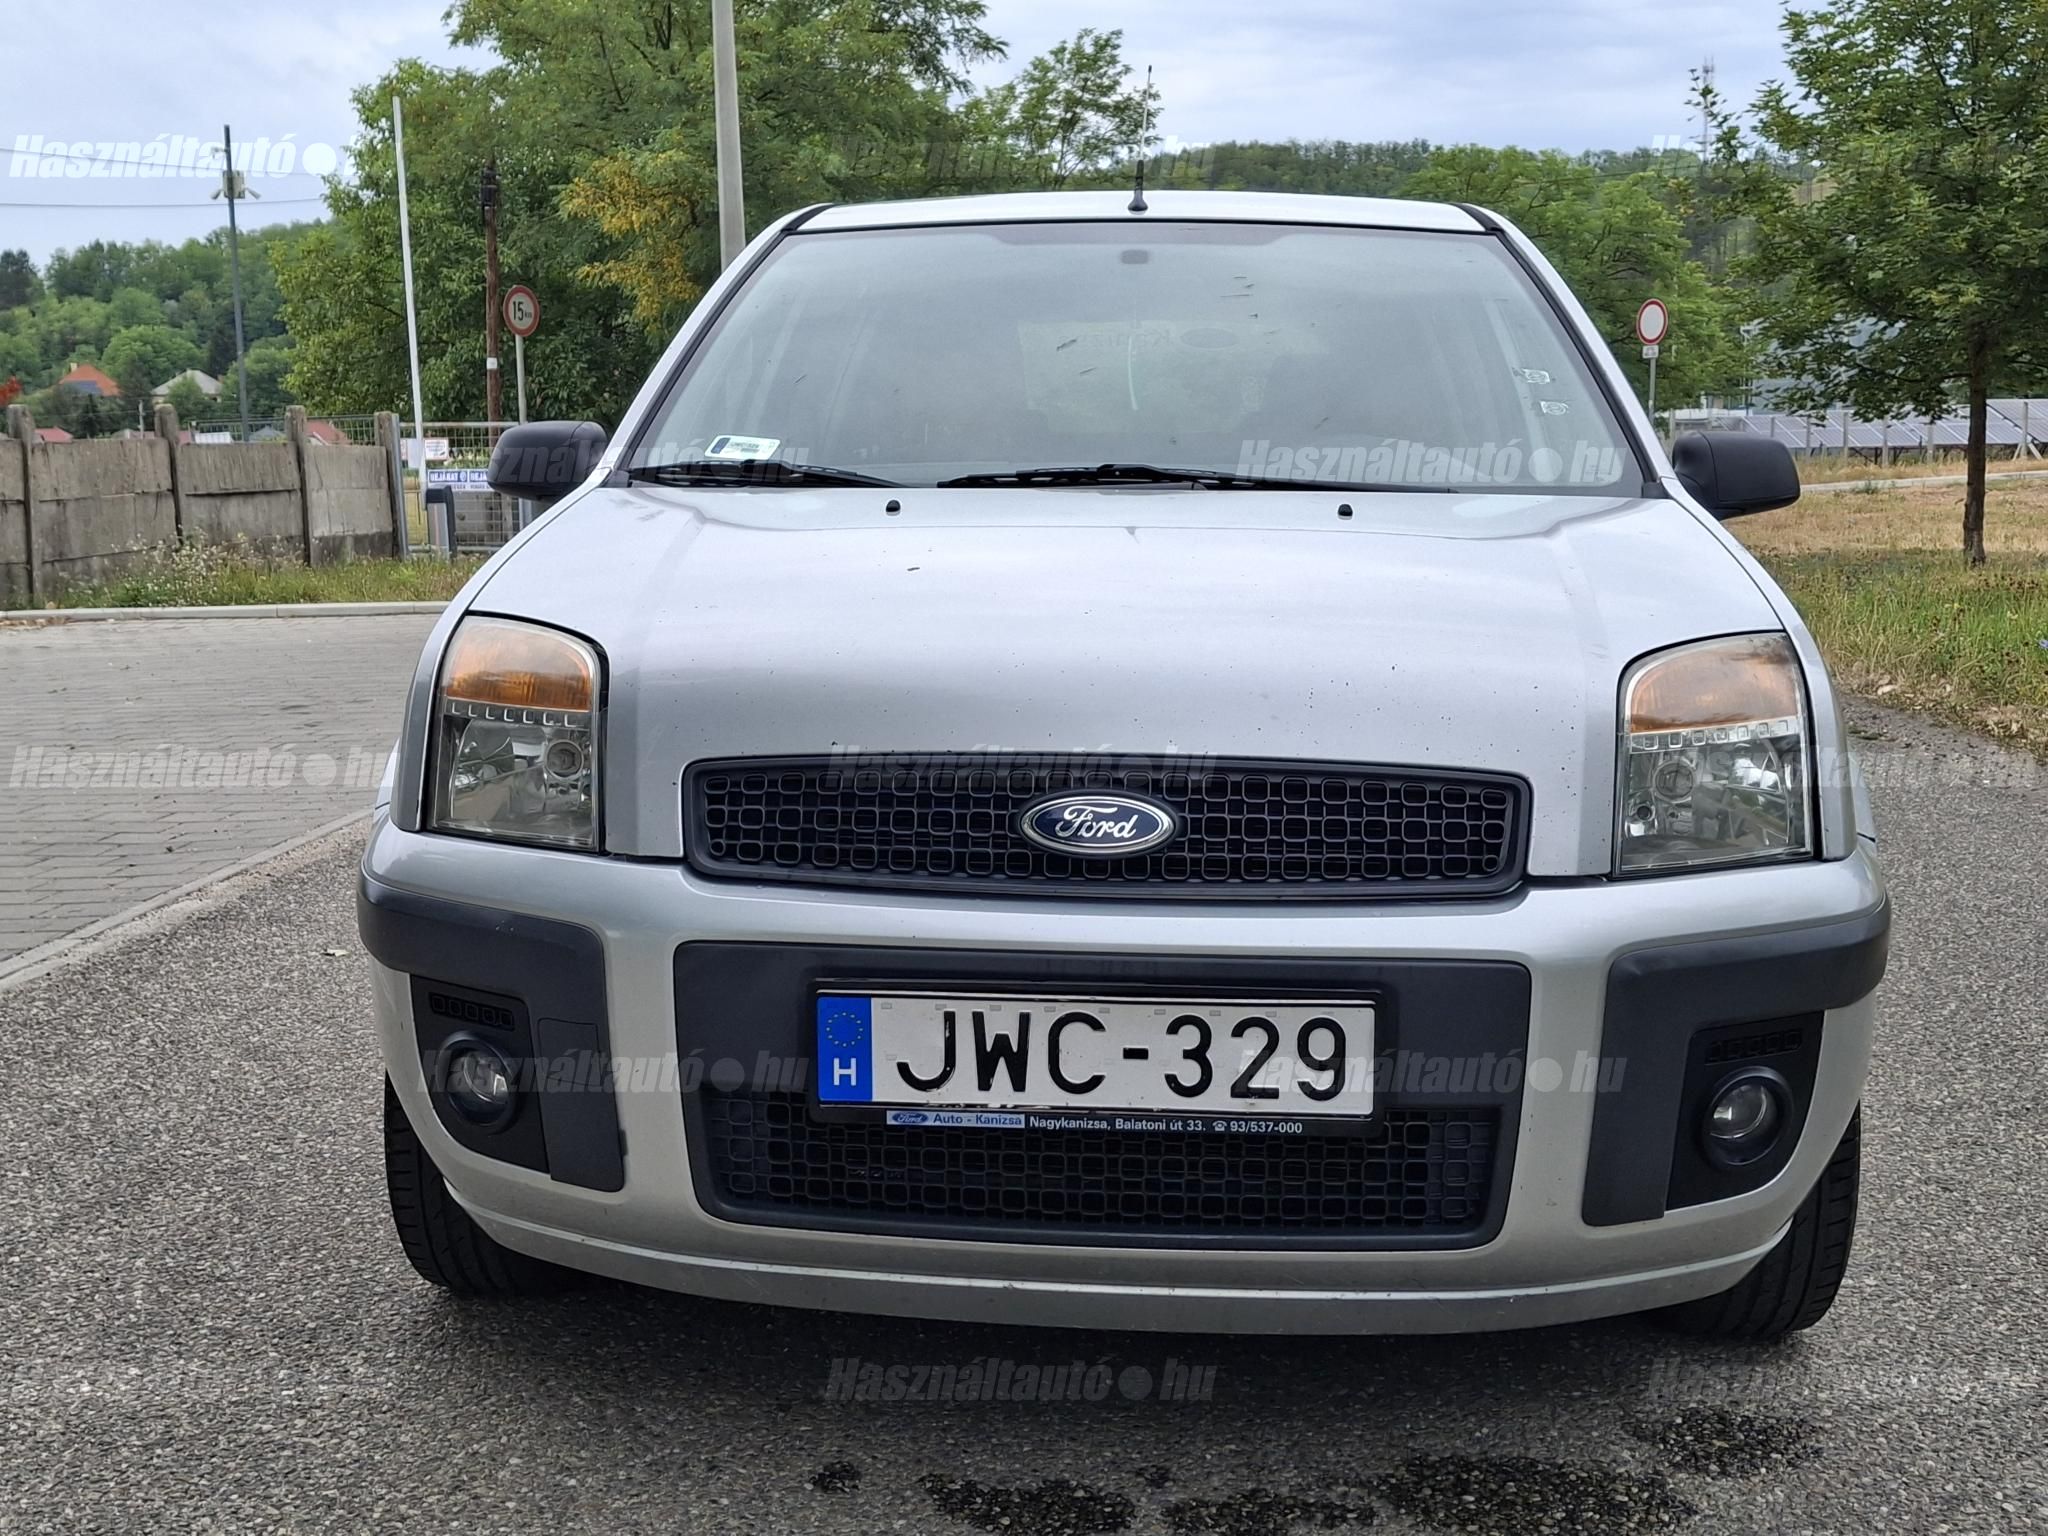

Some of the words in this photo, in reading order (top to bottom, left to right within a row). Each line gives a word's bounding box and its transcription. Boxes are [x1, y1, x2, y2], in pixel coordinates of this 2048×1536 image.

[512, 300, 524, 321] 15
[1054, 805, 1138, 840] Ford
[832, 1057, 857, 1086] H
[895, 1009, 1347, 1101] JWC-329
[933, 1113, 963, 1124] Auto
[975, 1114, 1022, 1125] Kanizsa
[1029, 1116, 1111, 1130] Nagykanizsa,
[1115, 1118, 1166, 1130] Balatoni
[1169, 1119, 1183, 1131] út
[1186, 1120, 1206, 1131] 33.
[1230, 1121, 1303, 1133] 93/537-000
